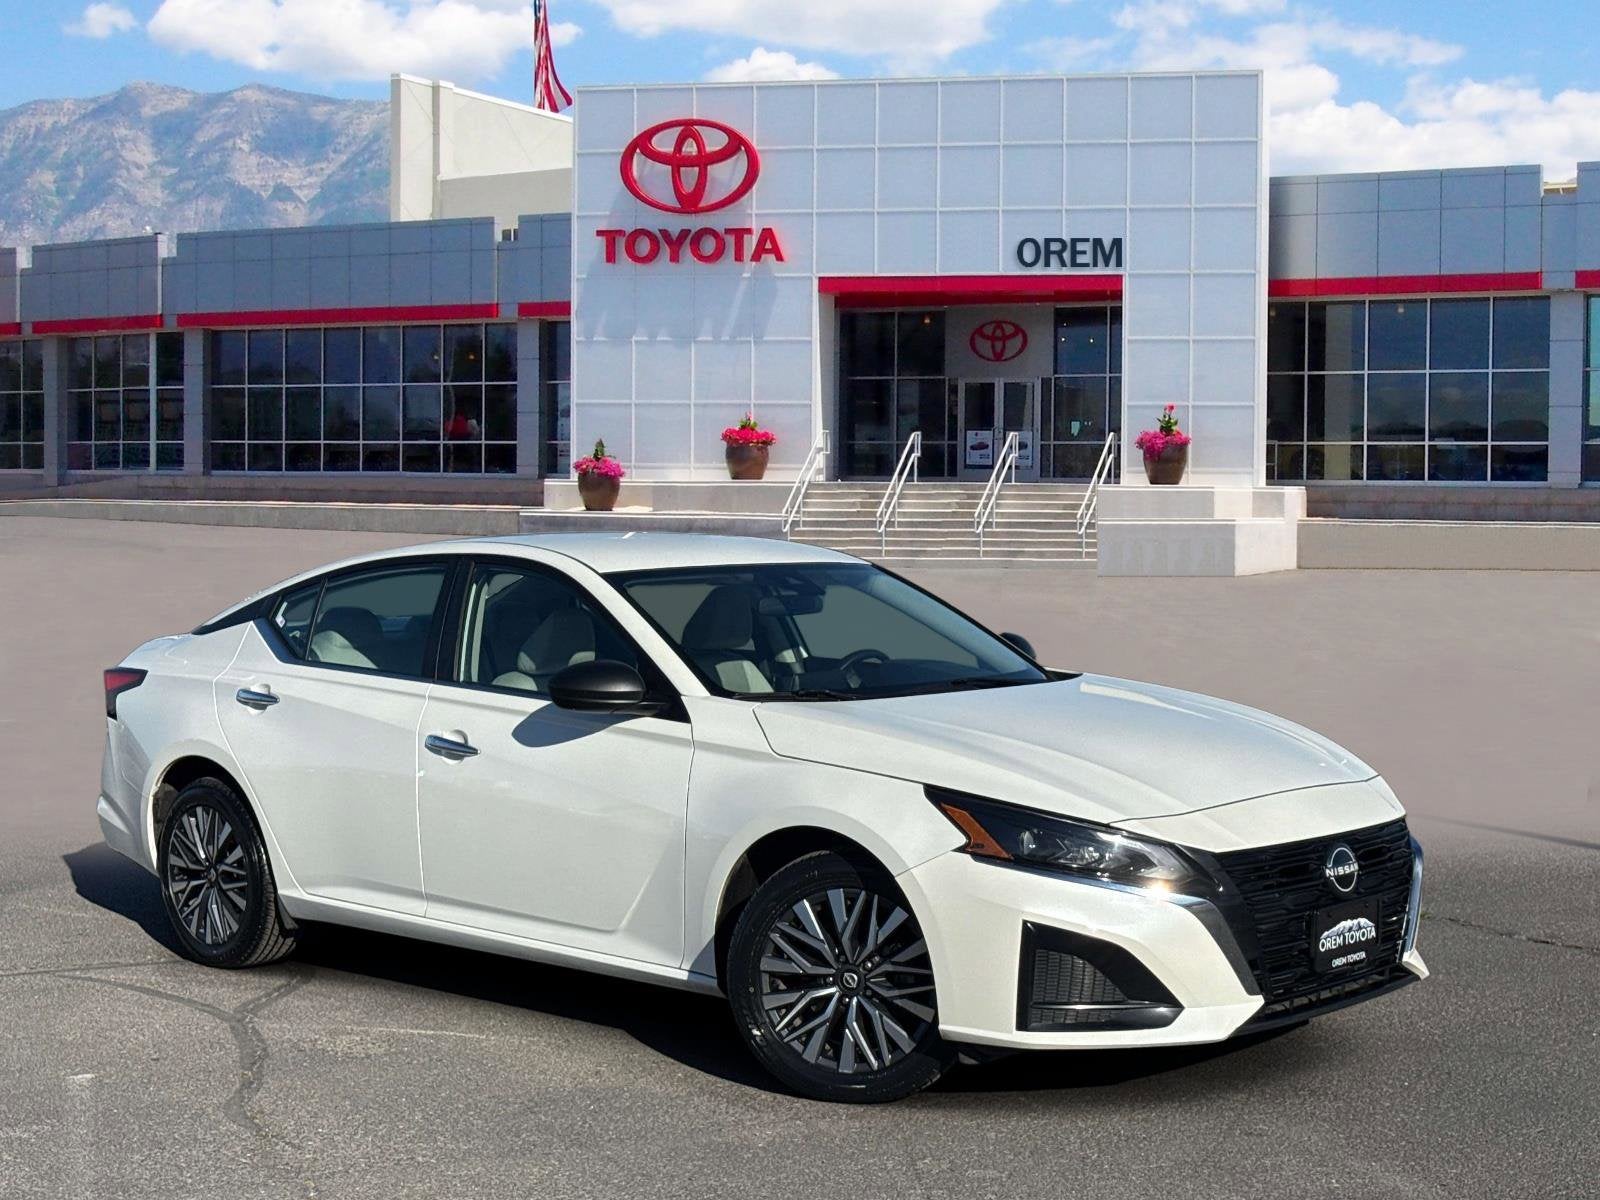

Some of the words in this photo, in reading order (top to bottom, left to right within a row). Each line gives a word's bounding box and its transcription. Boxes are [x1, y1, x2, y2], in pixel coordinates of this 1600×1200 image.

[596, 227, 785, 264] TOYOTA
[1016, 237, 1123, 268] OREM
[1326, 861, 1358, 877] NISSAN
[1319, 935, 1343, 952] OREM
[1345, 926, 1376, 944] TOYOTA
[1332, 956, 1346, 967] OREM
[1347, 951, 1366, 963] TOYOTA
